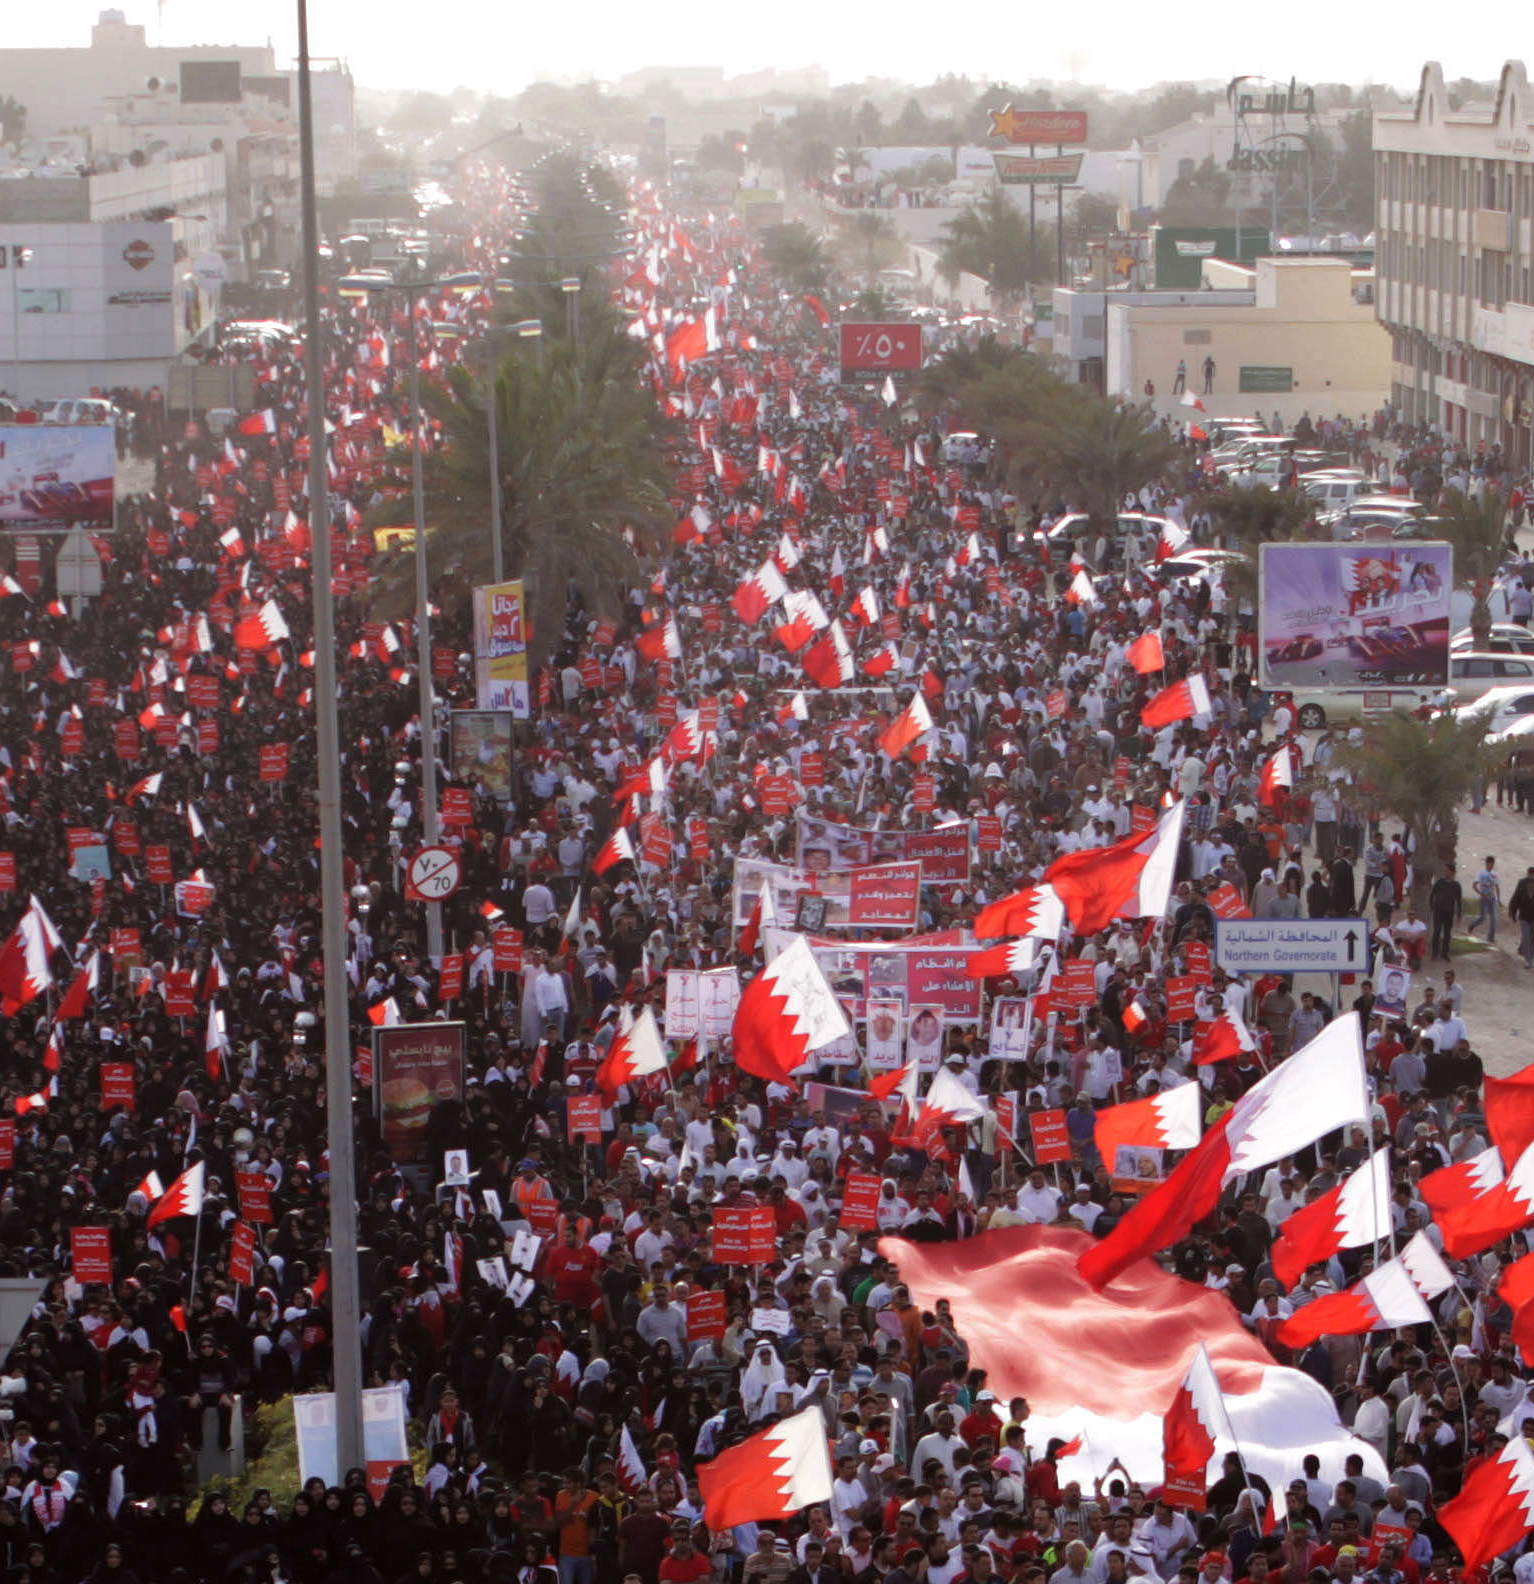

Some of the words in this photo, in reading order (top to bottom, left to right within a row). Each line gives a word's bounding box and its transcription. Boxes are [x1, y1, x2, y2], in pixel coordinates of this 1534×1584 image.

[433, 876, 451, 891] 70
[1225, 929, 1275, 945] الشمالية
[1278, 929, 1337, 943] المحافظة
[1225, 950, 1269, 961] Northern
[1273, 950, 1337, 961] Governorate
